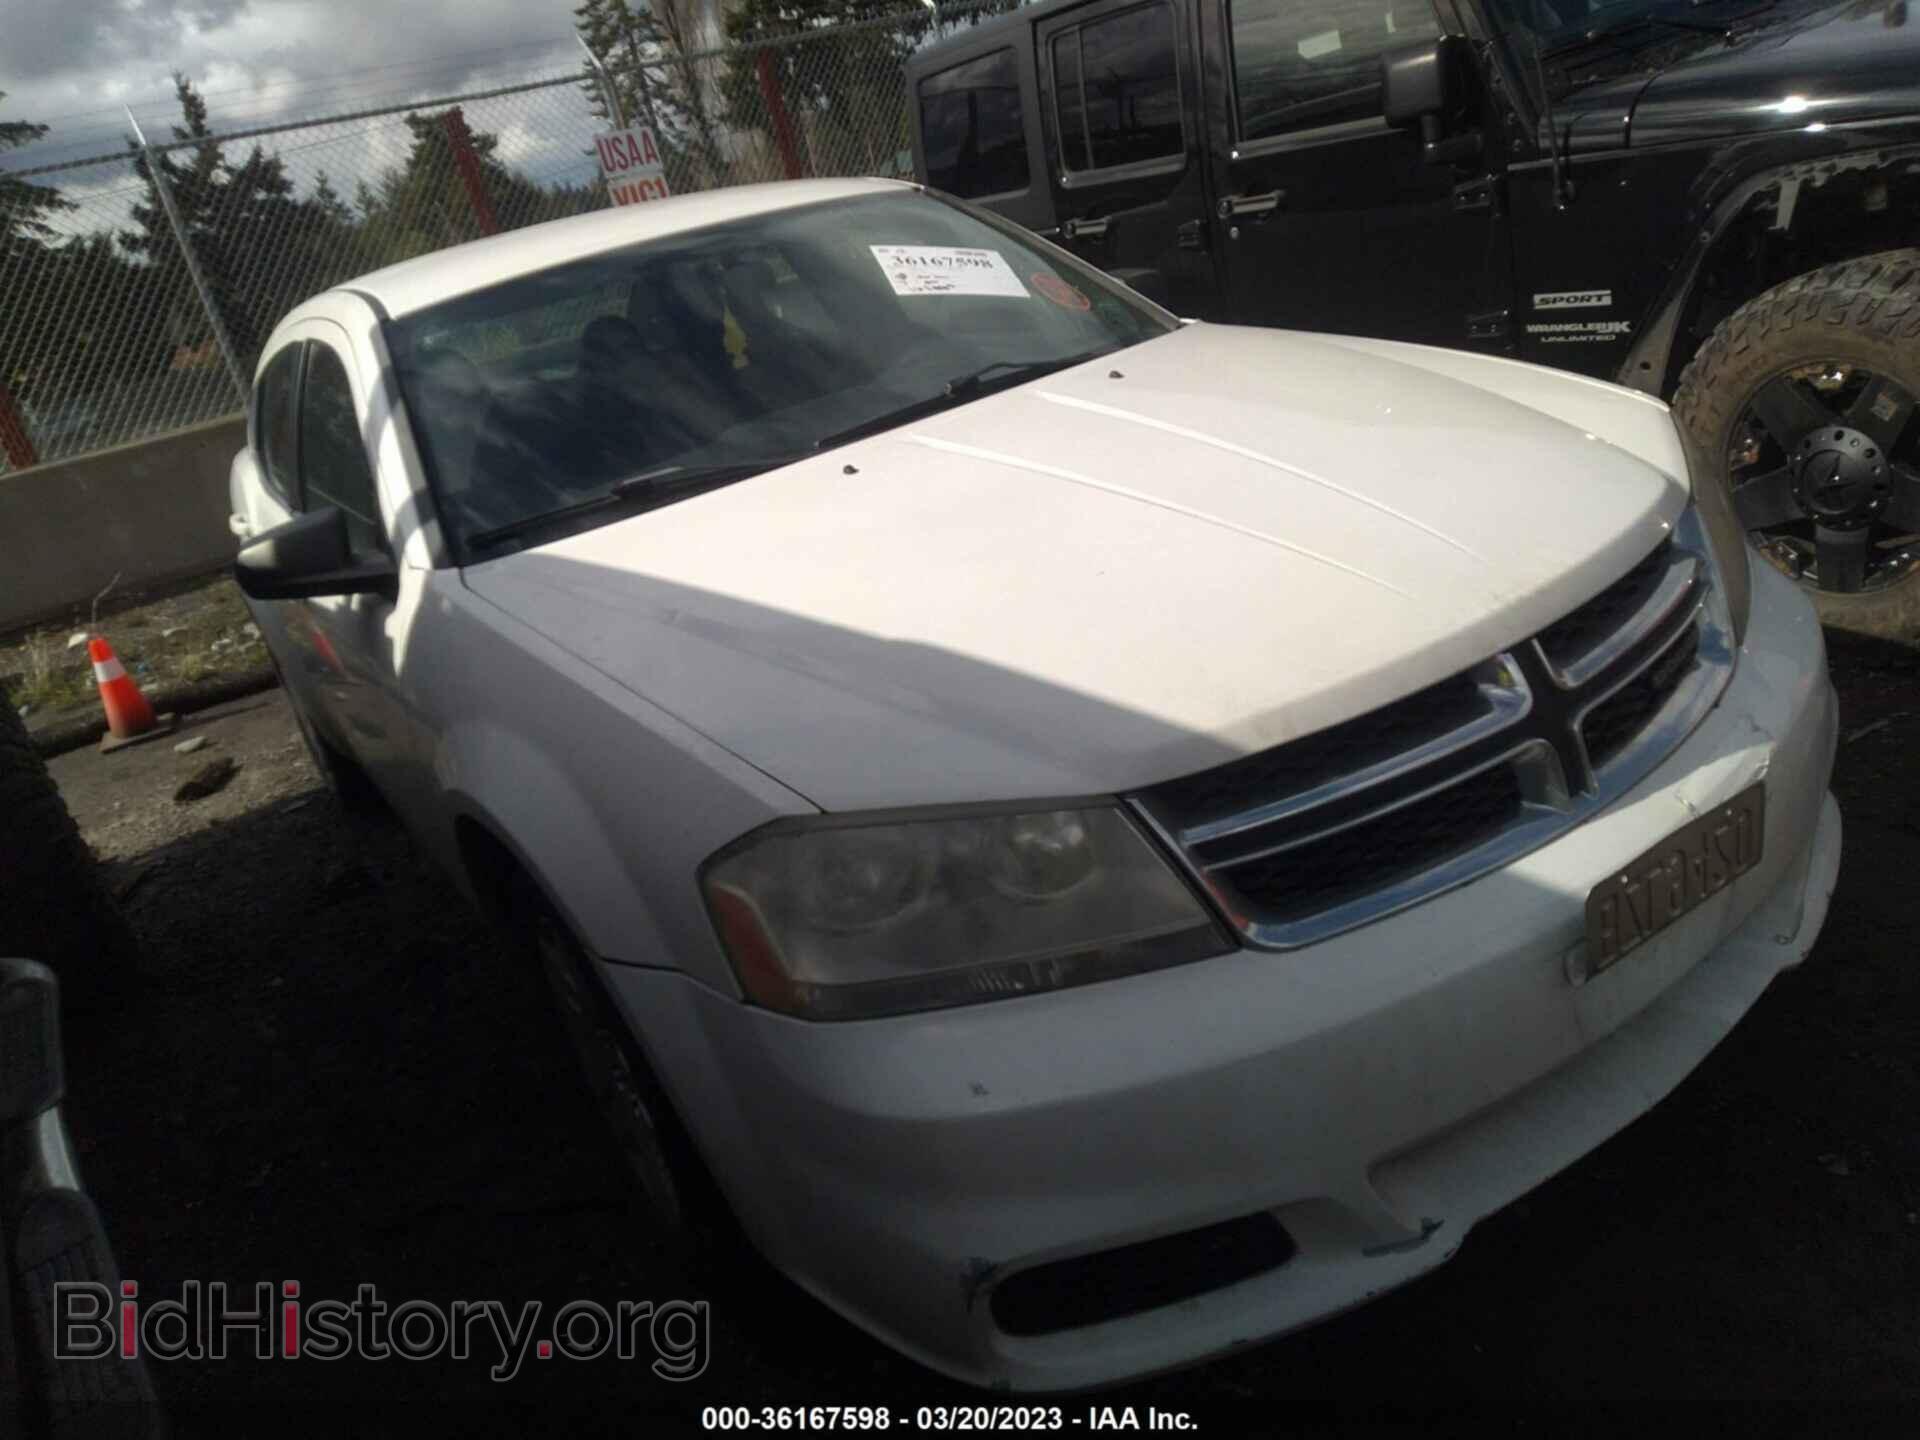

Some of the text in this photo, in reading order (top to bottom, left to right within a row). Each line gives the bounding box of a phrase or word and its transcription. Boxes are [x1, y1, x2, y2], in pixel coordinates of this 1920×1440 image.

[595, 130, 660, 173] USAA
[1538, 294, 1605, 306] SPORT
[1539, 334, 1617, 343] UNLIMITED
